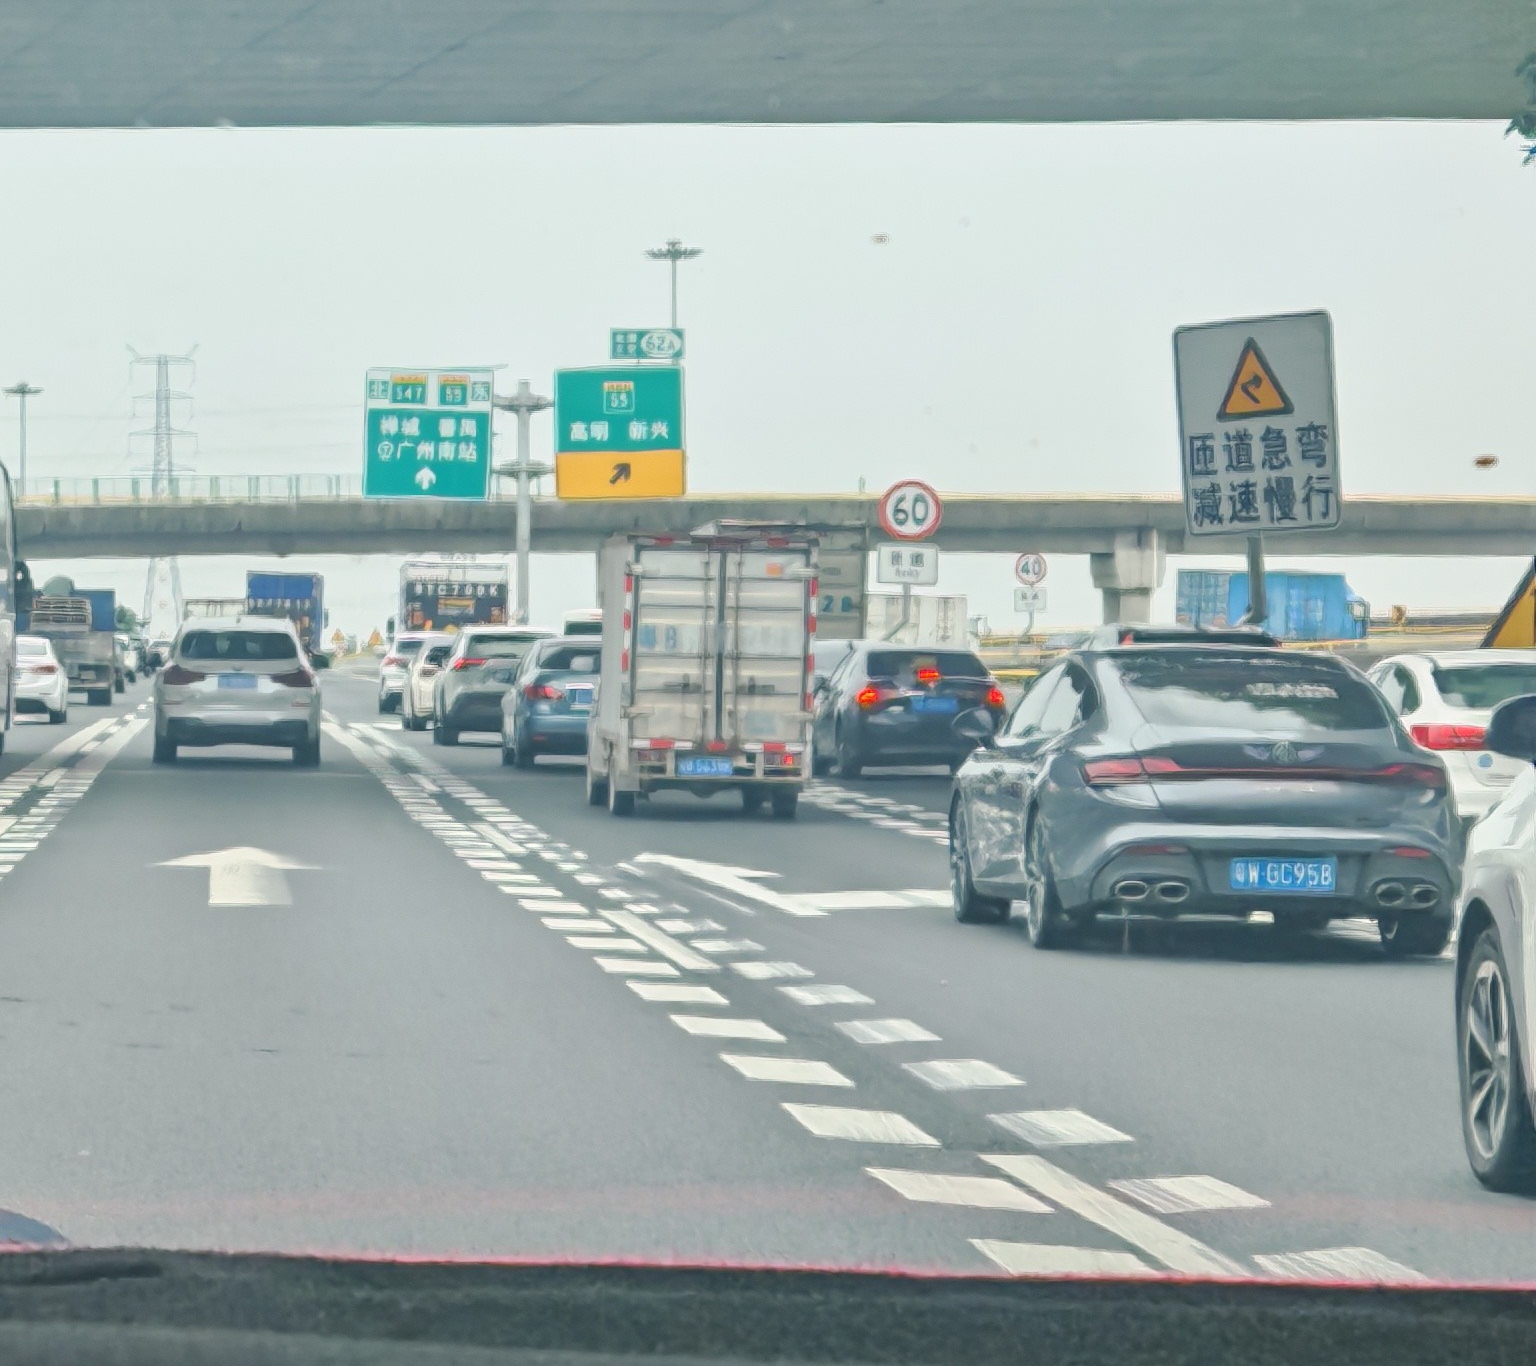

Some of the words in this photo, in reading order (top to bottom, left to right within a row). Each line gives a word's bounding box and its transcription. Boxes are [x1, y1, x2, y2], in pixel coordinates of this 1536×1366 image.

[1190, 421, 1329, 475] 匝道急弯
[892, 493, 929, 526] 60
[1192, 474, 1333, 527] 减速慢行
[1020, 558, 1042, 576] 40
